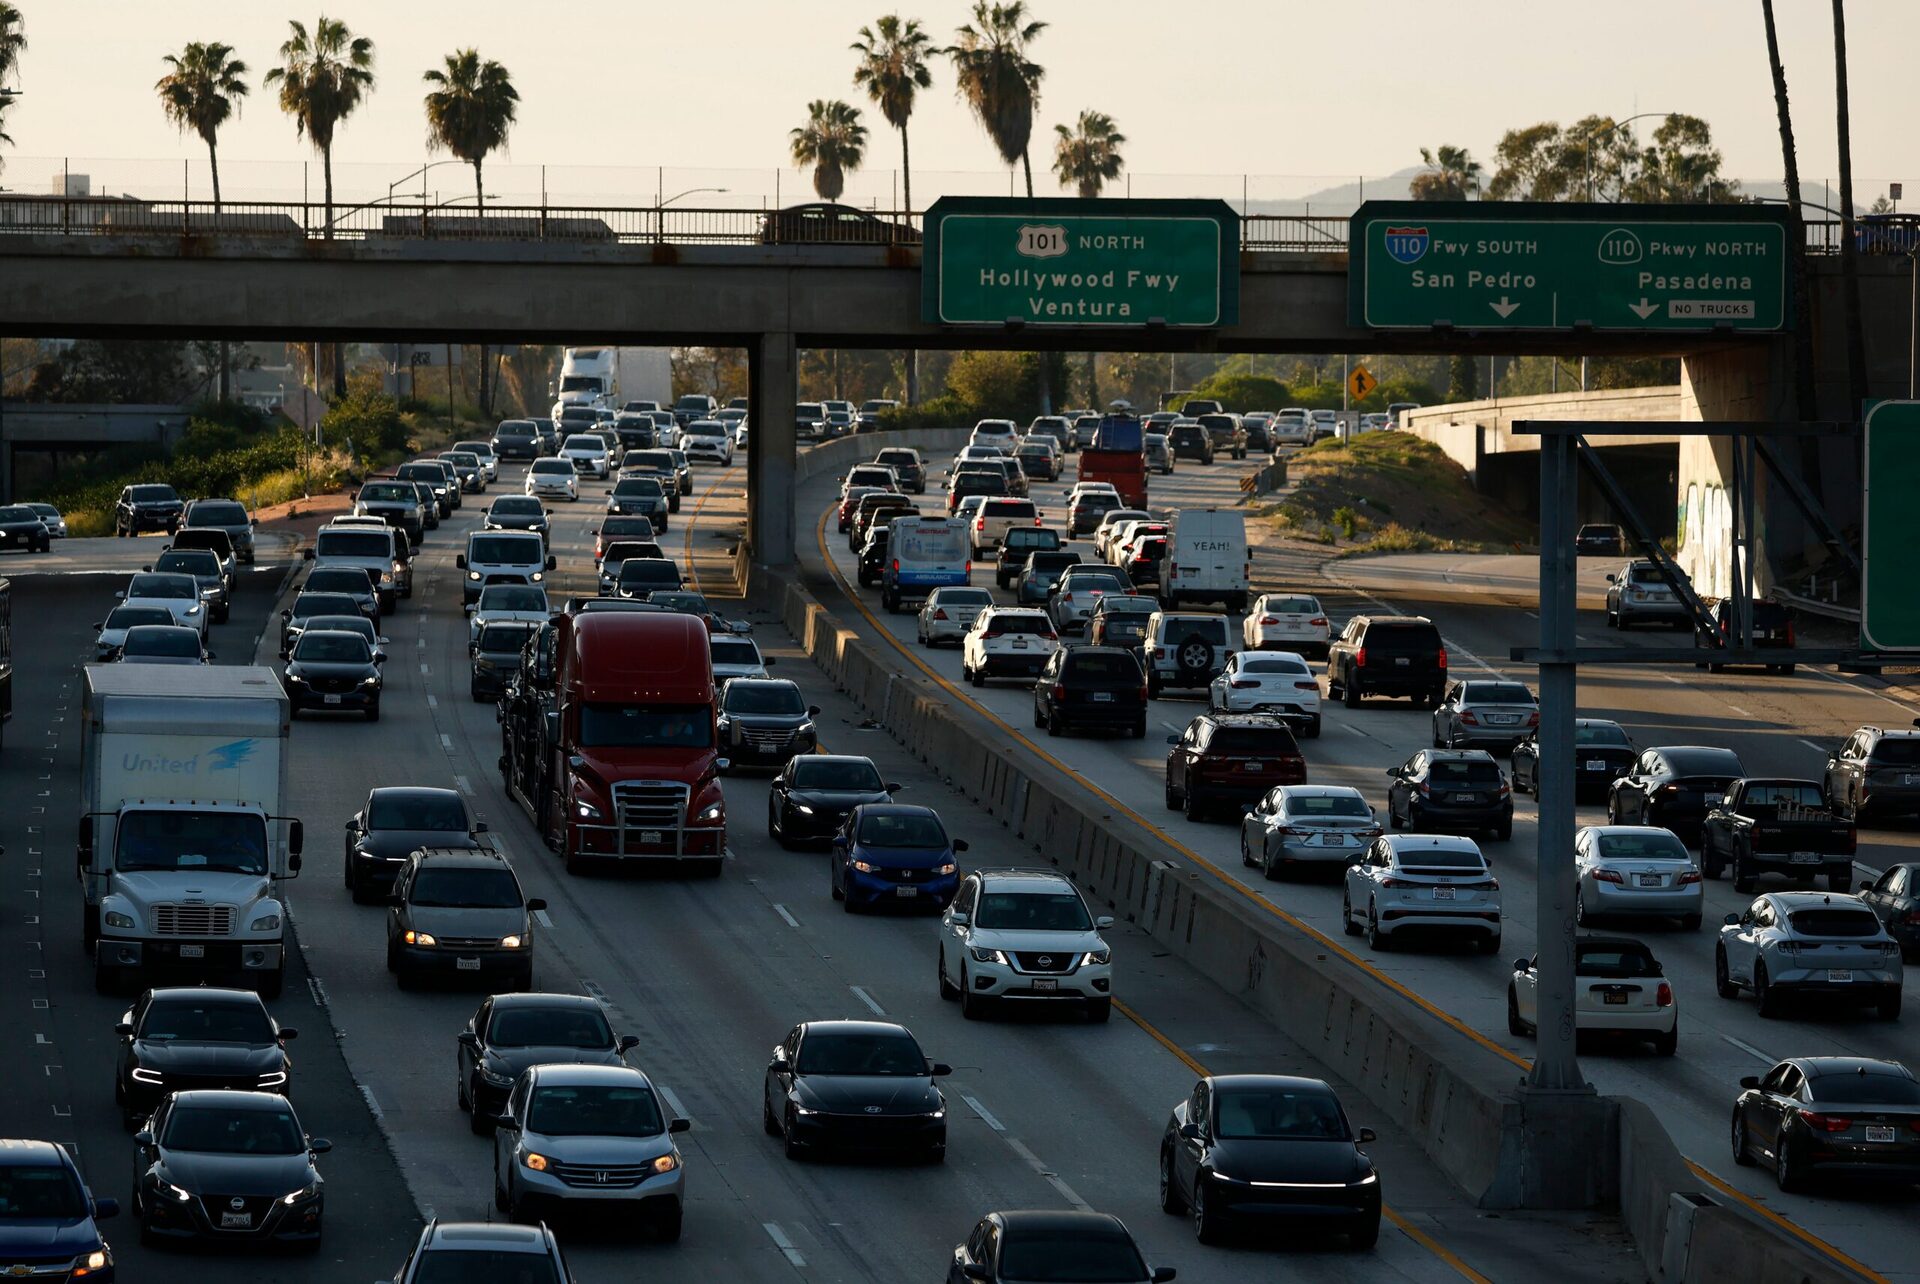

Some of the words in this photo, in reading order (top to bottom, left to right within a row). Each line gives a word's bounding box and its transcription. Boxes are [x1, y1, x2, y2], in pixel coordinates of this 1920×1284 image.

[1028, 233, 1058, 250] 101
[1079, 235, 1146, 250] NORTH
[1393, 237, 1421, 255] 110
[1433, 239, 1469, 257] Fwy
[1476, 240, 1538, 254] SOUTH
[1607, 239, 1635, 257] 110
[1649, 241, 1698, 259] Pkwy
[1704, 242, 1767, 256] NORTH
[979, 268, 1115, 291] Hollywood
[1127, 270, 1180, 292] Fwy
[1410, 269, 1455, 288] San
[1467, 270, 1537, 289] Pedro
[1638, 271, 1753, 290] Pasadena
[1028, 297, 1131, 316] Ventura
[1674, 304, 1692, 314] NO
[1699, 304, 1750, 315] TRUCKS
[1193, 541, 1230, 551] YEAH!
[122, 752, 199, 774] United
